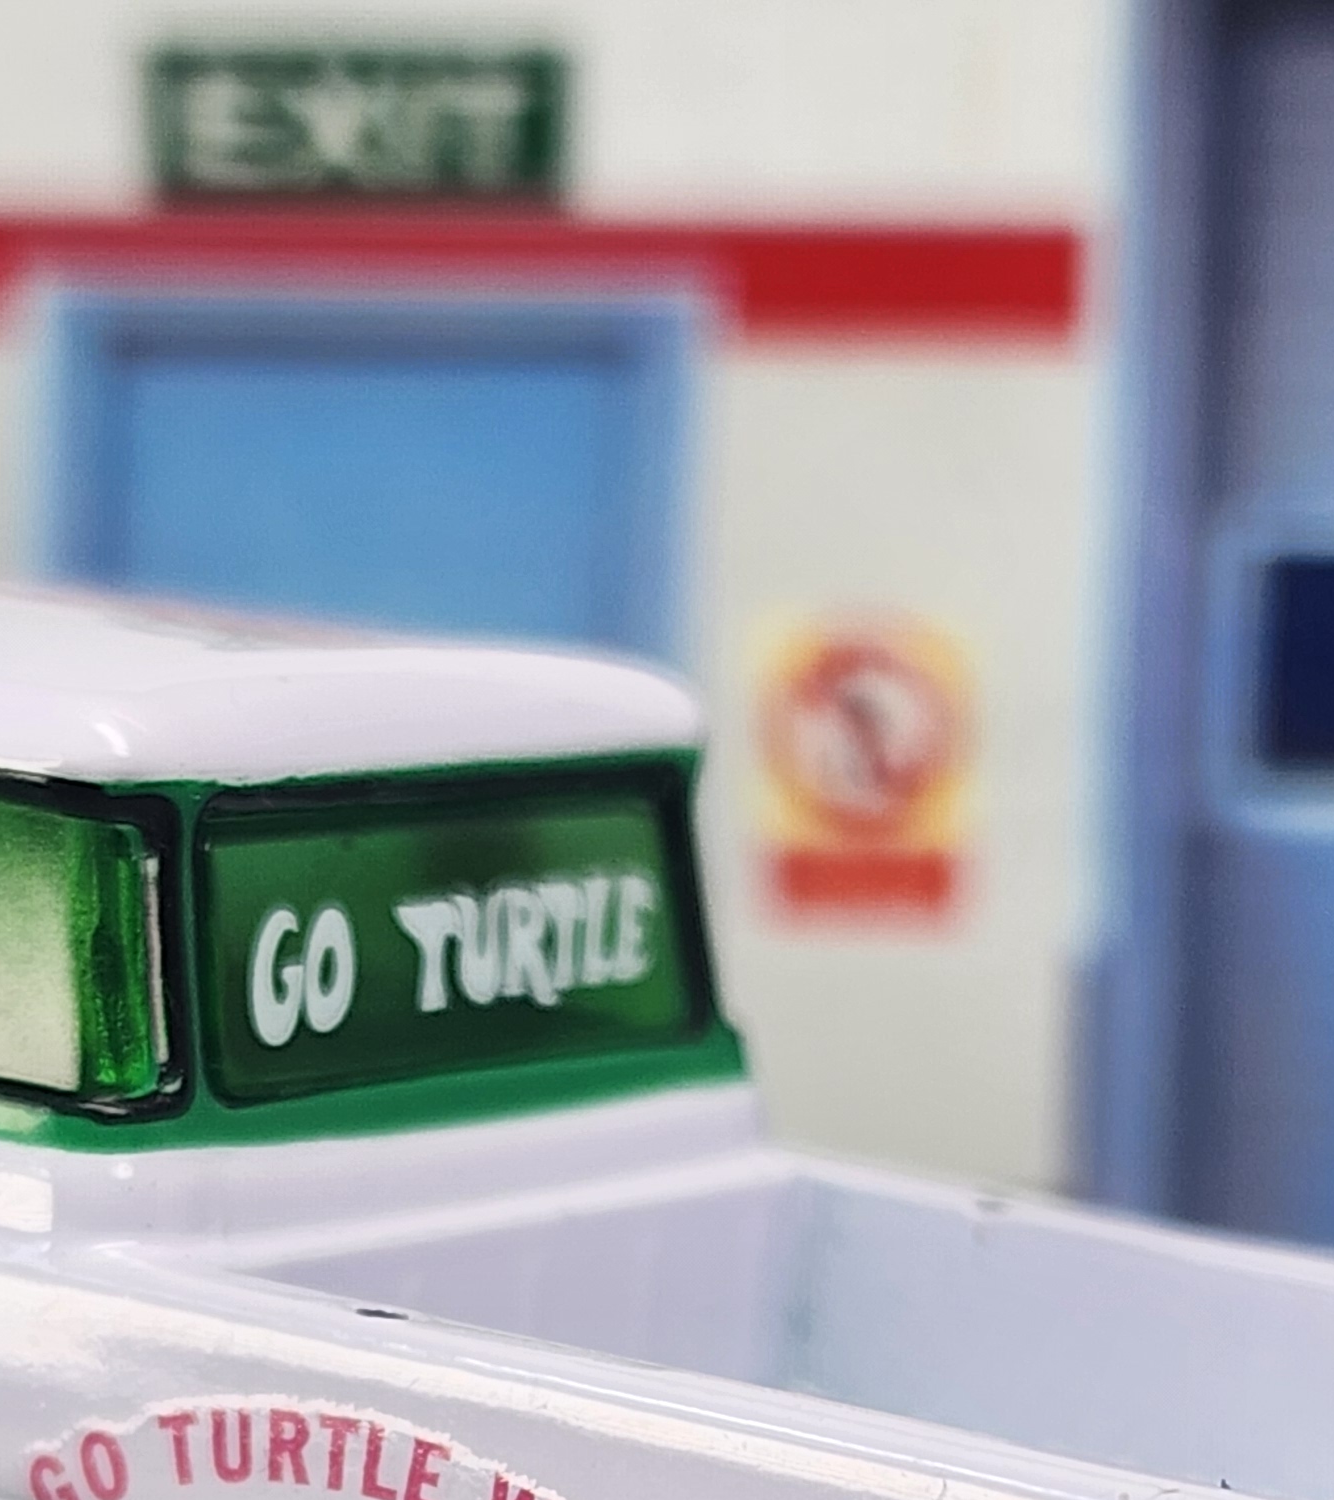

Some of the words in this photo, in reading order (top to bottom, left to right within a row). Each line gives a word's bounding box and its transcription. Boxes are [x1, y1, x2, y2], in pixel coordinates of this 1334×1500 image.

[179, 72, 527, 192] EXIT
[250, 908, 357, 1047] GO
[394, 874, 657, 1014] TURTLE
